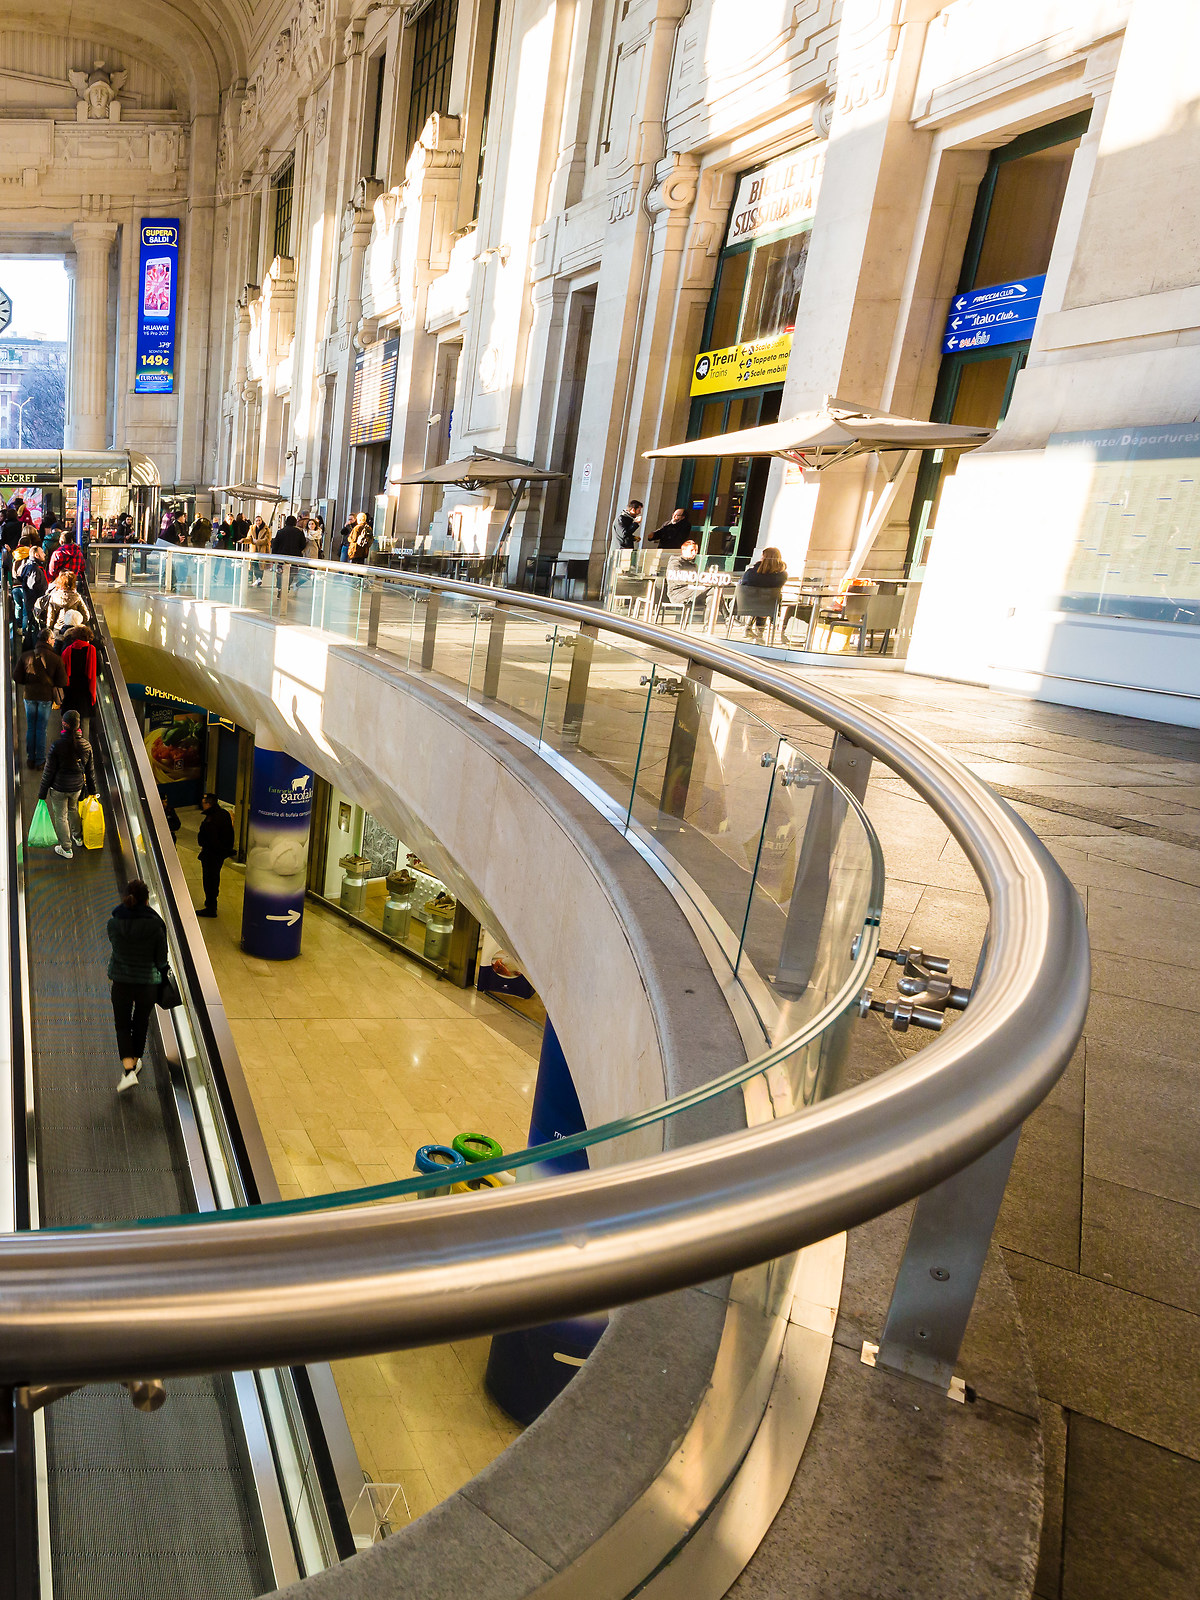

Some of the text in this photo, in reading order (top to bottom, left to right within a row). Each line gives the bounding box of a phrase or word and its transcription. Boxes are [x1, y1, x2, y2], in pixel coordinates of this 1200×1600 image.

[145, 229, 173, 237] SUPERA
[141, 354, 169, 366] 149€
[711, 348, 739, 367] Treni
[709, 367, 728, 379] Trains
[750, 369, 766, 378] Scale
[1, 473, 37, 482] SECRET
